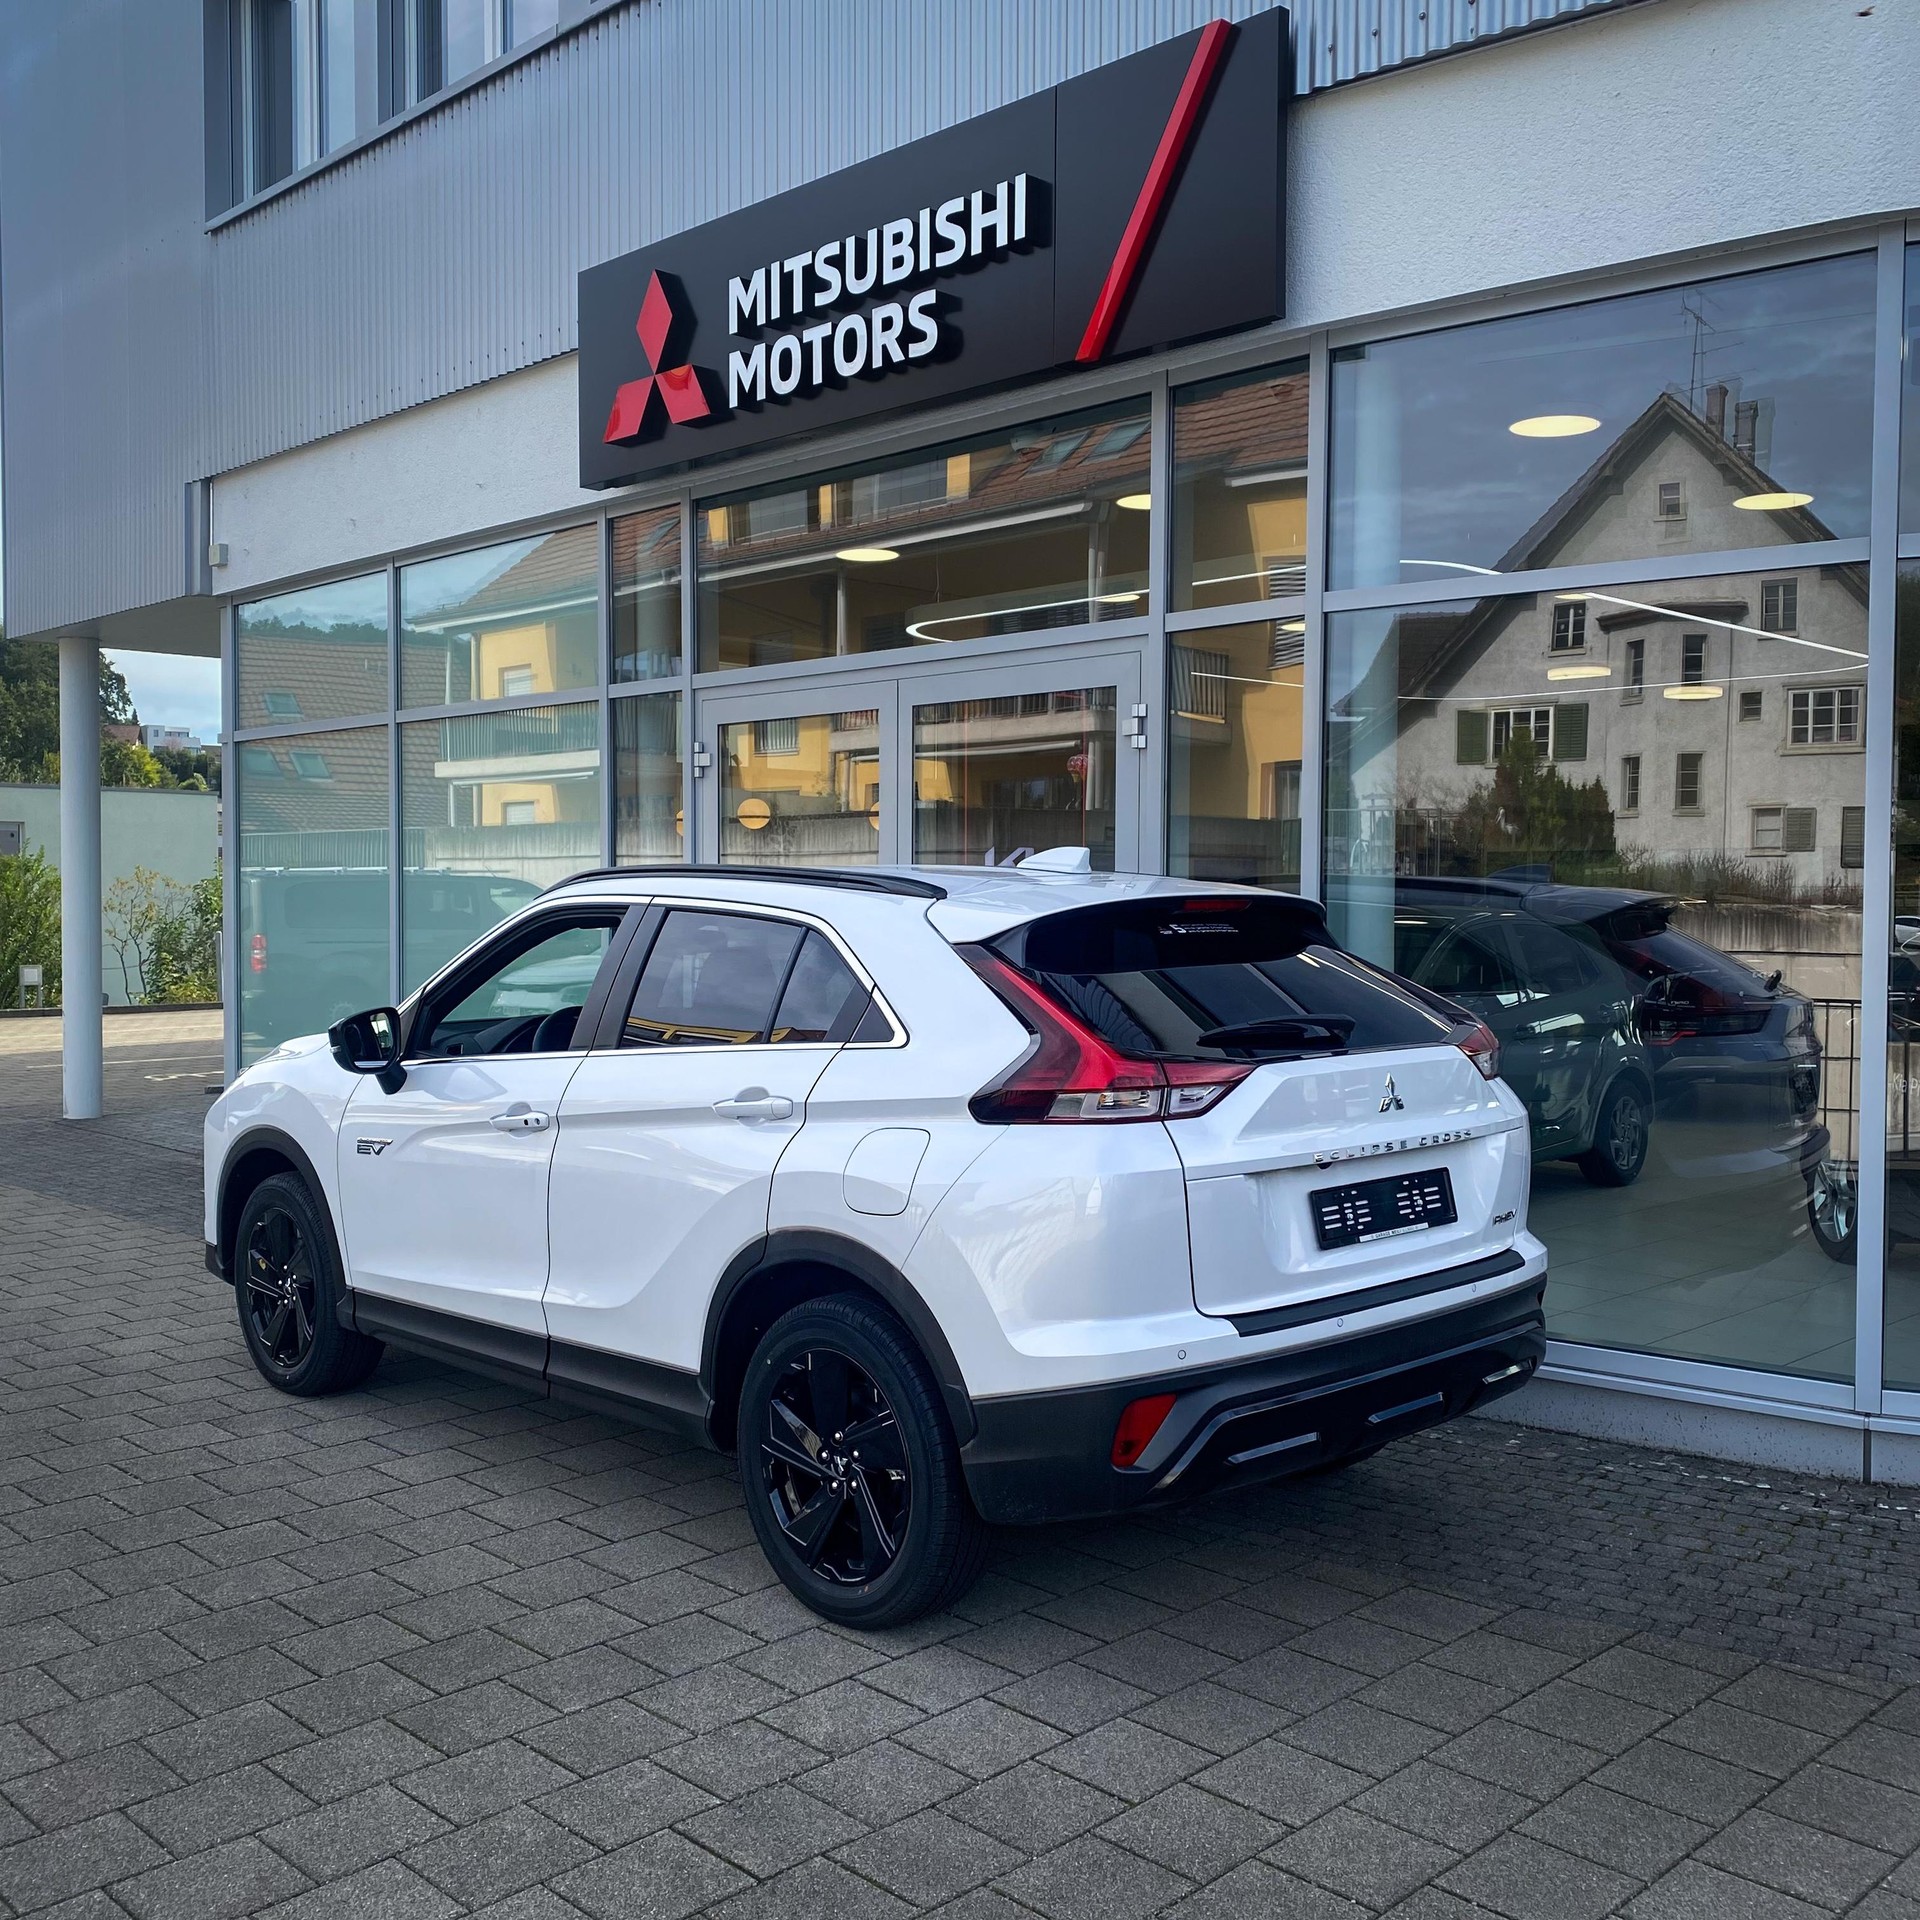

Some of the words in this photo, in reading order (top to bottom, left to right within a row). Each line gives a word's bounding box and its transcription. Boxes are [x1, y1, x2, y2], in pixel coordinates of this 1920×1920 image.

[728, 172, 1028, 335] MITSUBISHI
[728, 289, 938, 409] MOTORS
[357, 1144, 387, 1156] EV
[1313, 1140, 1408, 1163] ECLIPSE
[1419, 1129, 1472, 1147] CROSS
[1492, 1209, 1518, 1226] PHEV
